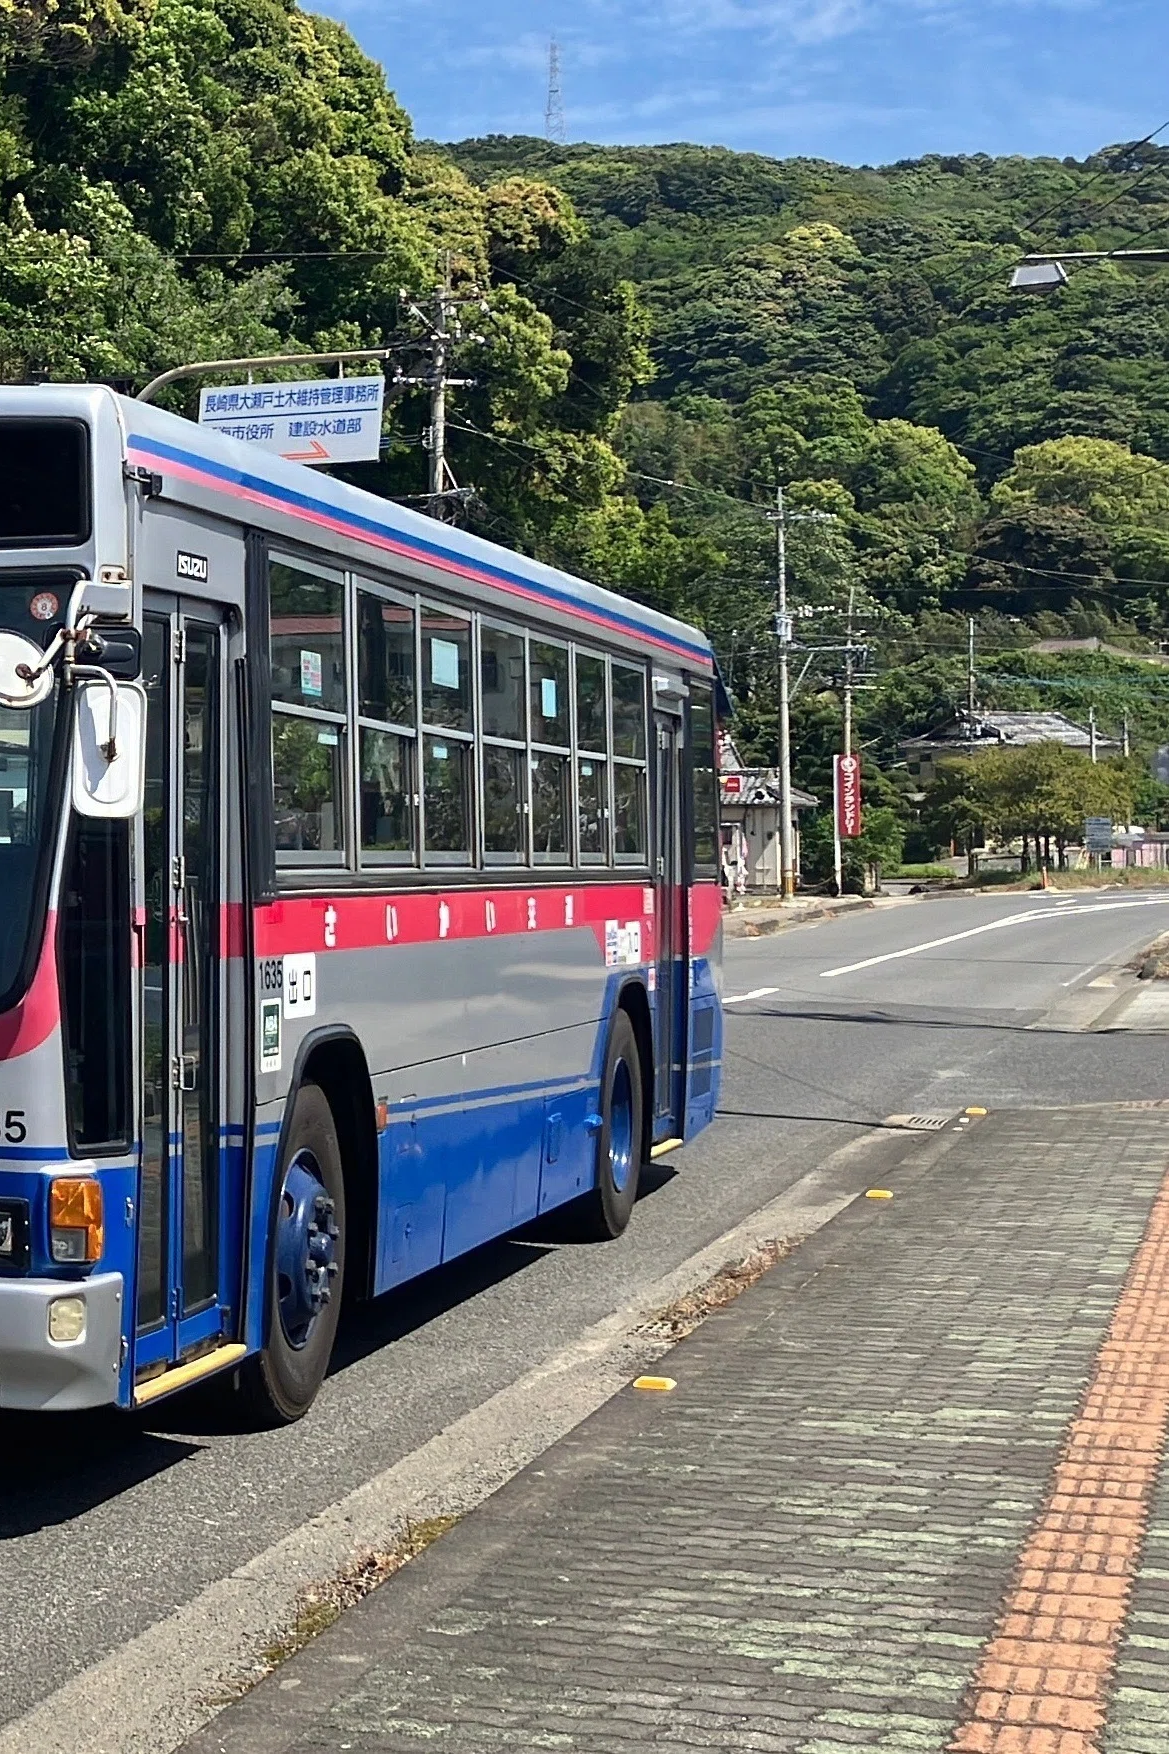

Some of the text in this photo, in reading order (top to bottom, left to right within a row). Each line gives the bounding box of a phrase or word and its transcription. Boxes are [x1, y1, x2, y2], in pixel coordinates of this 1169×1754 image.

[288, 417, 362, 438] 建設水道部
[178, 554, 207, 579] ISUZU
[843, 772, 856, 835] コインランドリー
[259, 960, 283, 990] 1635
[288, 968, 311, 1005] 出口
